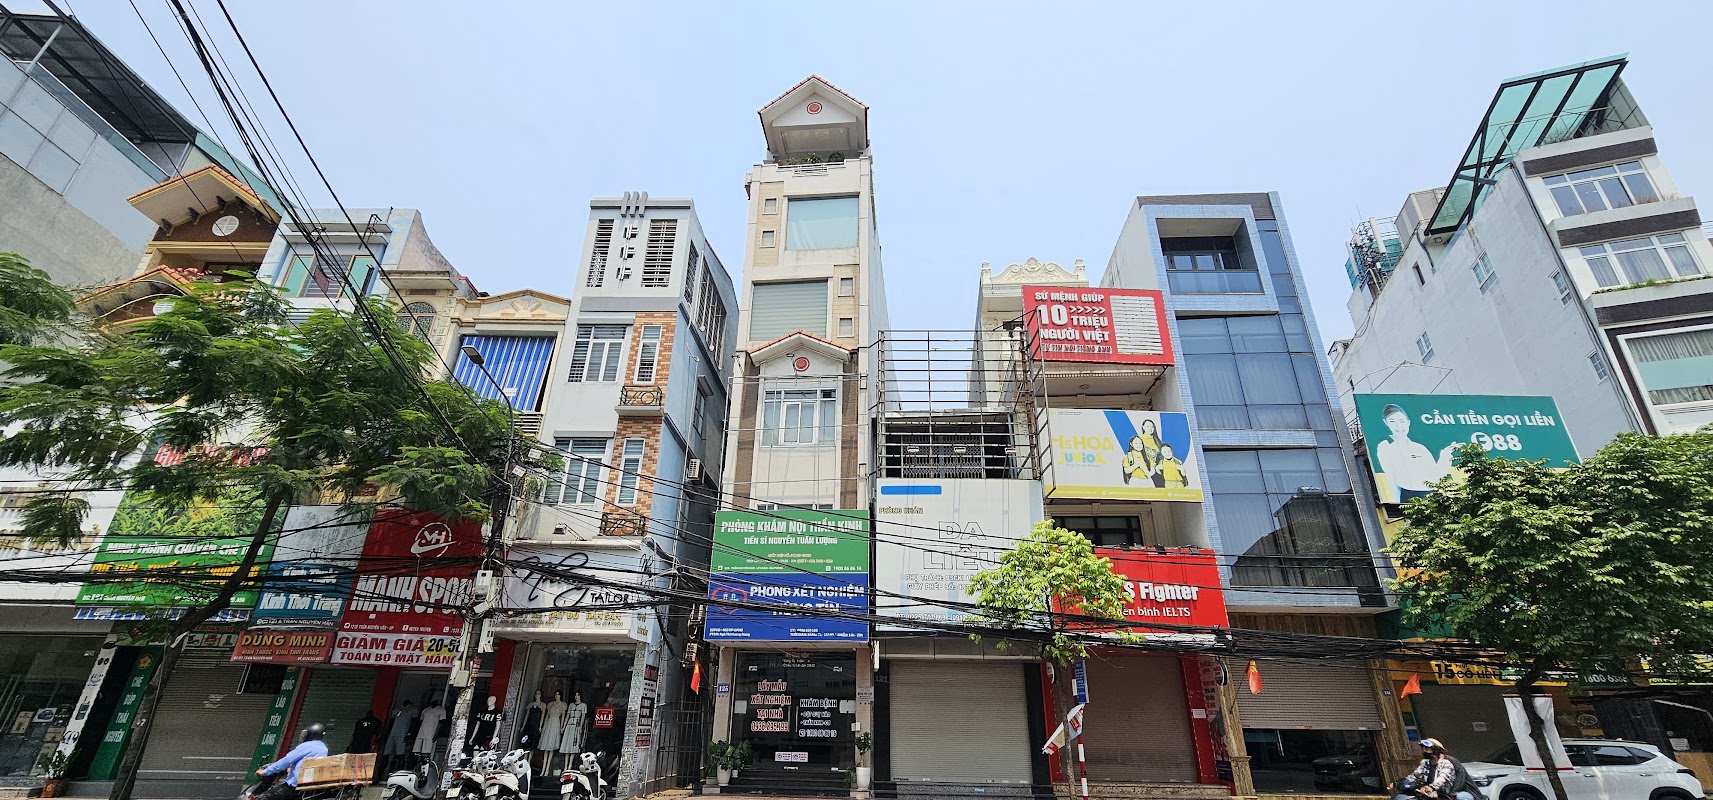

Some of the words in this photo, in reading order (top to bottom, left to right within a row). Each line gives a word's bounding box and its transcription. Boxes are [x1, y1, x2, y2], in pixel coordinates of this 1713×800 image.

[1035, 292, 1048, 301] SỨ
[1051, 291, 1078, 303] MỆNH
[1081, 292, 1104, 302] GIÚP
[1038, 304, 1068, 326] 10
[1071, 314, 1108, 328] TRIỆU
[1040, 327, 1080, 341] NGƯỜI
[1082, 328, 1110, 344] VIỆT
[1421, 409, 1456, 425] CẦN
[1457, 409, 1490, 426] TIỀN
[1492, 415, 1522, 429] GỌI
[1525, 411, 1556, 427] LIỀN
[879, 506, 903, 514] PHÒNG
[721, 519, 755, 533] PHÒNG
[757, 519, 786, 533] KHÁM
[789, 519, 806, 534] NỘI
[838, 520, 863, 532] KINH
[938, 521, 987, 540] DA
[744, 536, 759, 545] TIẾN
[760, 536, 768, 545] SĨ
[768, 535, 796, 545] NGUYỄN
[797, 535, 814, 545] TUẤN
[815, 537, 838, 546] LƯỢNG
[350, 575, 417, 619] MẠNH
[590, 591, 630, 604] TAILOR
[1139, 583, 1200, 603] Fighter
[1137, 607, 1161, 617] binh
[1162, 608, 1191, 617] IELTS
[241, 631, 285, 648] DŨNG
[288, 635, 328, 648] MINH
[336, 634, 388, 650] GIẢM
[393, 636, 425, 652] GIÁ
[340, 651, 372, 662] TOÀN
[374, 652, 392, 663] BỘ
[394, 653, 423, 665] MẶT
[1435, 664, 1455, 679] 15
[718, 684, 729, 692] 125
[758, 679, 771, 692] LẤY
[771, 679, 788, 692] MẪU
[751, 694, 764, 706] XÉT
[764, 695, 792, 707] NGHIỆM
[799, 697, 819, 708] KHÁM
[819, 698, 838, 710] BỆNH
[594, 713, 614, 721] SALE
[757, 708, 768, 721] TẠI
[769, 707, 784, 720] NHÀ
